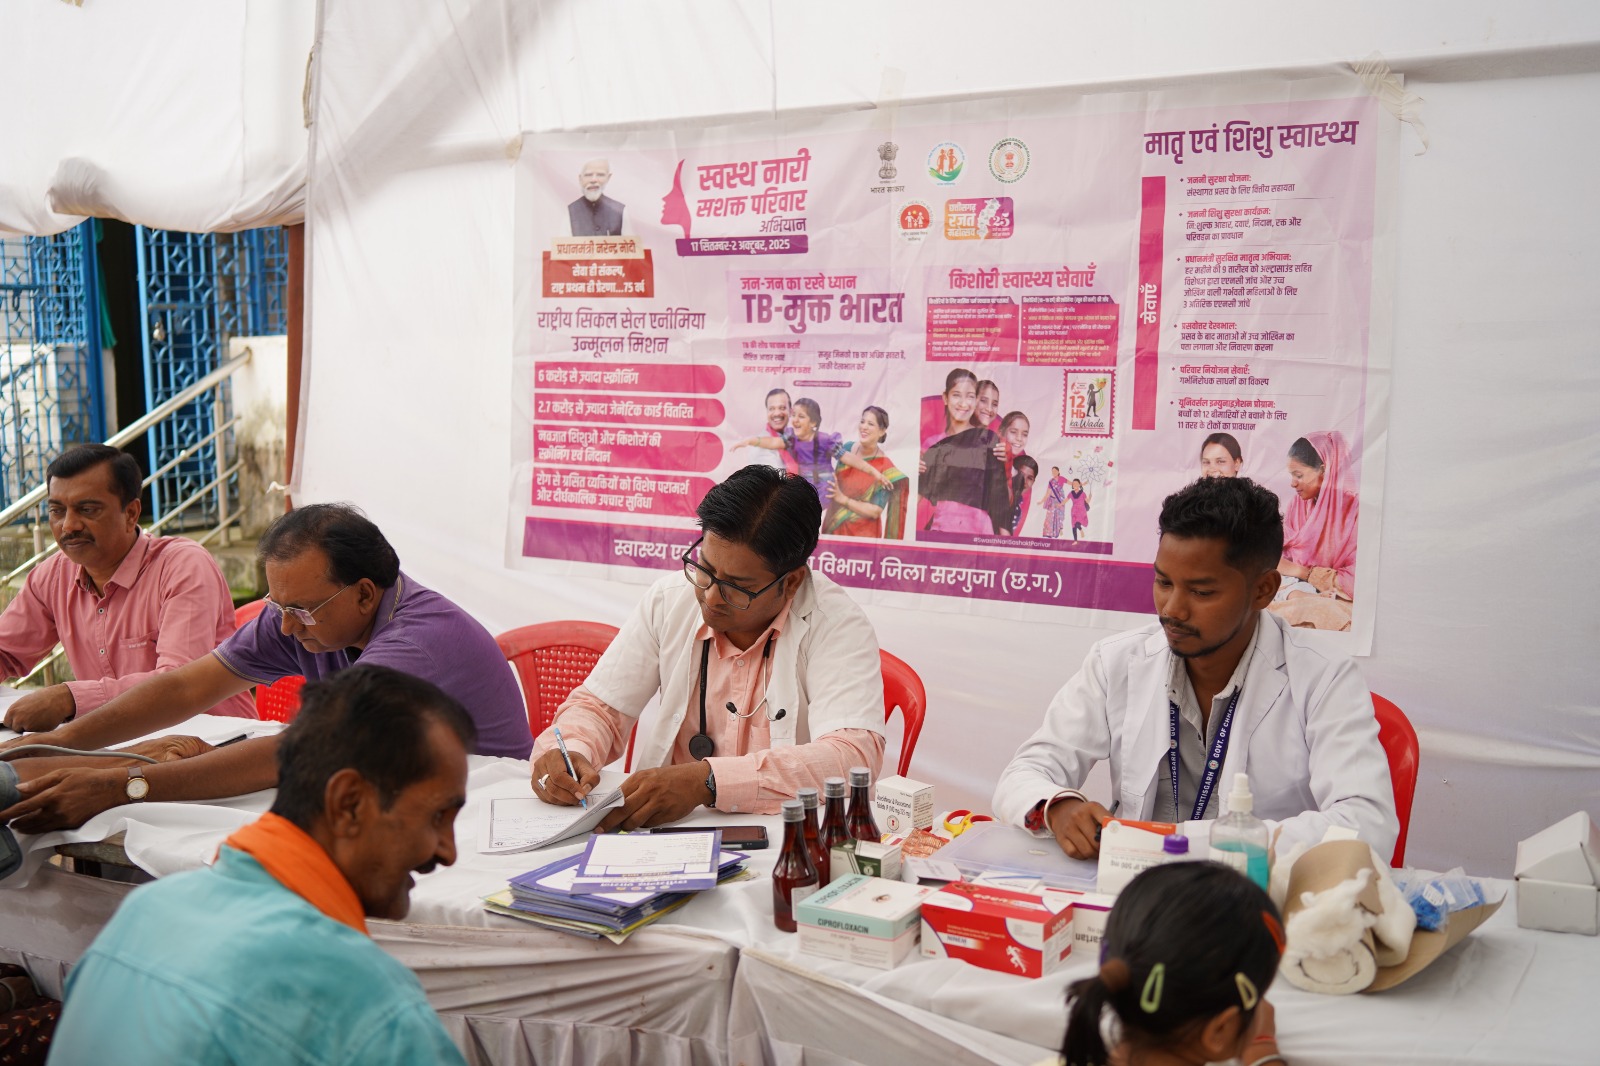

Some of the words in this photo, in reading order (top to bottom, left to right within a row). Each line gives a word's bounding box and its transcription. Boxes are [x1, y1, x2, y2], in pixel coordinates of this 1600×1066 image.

[1144, 132, 1185, 164] मातृ
[1189, 123, 1219, 152] एवं
[1223, 121, 1273, 159] शिशु
[1278, 121, 1359, 149] स्वास्थ्य
[698, 160, 757, 192] स्वस्थ
[761, 148, 812, 184] नारी
[1187, 174, 1207, 184] जननी
[1208, 175, 1227, 186] सुरक्षा
[696, 195, 748, 218] सशक्त
[751, 187, 807, 215] परिवार
[948, 214, 976, 228] रजत
[993, 213, 1010, 227] 25
[1188, 209, 1207, 218] जननी
[1208, 208, 1222, 219] शिशु
[1224, 209, 1242, 219] सुरक्षा
[1289, 217, 1301, 226] और
[760, 216, 807, 233] अभियान
[1186, 233, 1210, 241] परिवहन
[1221, 232, 1244, 240] प्रावधान
[691, 242, 698, 252] 17
[769, 239, 790, 250] 2025
[950, 268, 1000, 289] किशोरी
[1002, 271, 1053, 289] स्वास्थ्य
[1056, 262, 1096, 288] सेवाएँ
[1195, 265, 1211, 273] महीने
[1228, 264, 1249, 273] तारीख
[1251, 264, 1259, 273] को
[1295, 263, 1312, 272] सहित
[740, 277, 784, 291] जन-जन
[786, 277, 801, 290] का
[804, 273, 825, 290] रखे
[828, 275, 857, 289] ध्यान
[537, 307, 572, 331] राष्ट्रीय
[576, 308, 617, 329] सिकल
[620, 308, 645, 329] सेल
[650, 308, 707, 330] एनीमिया
[742, 294, 834, 334] TB-मुक्त
[840, 293, 905, 323] भारत
[1197, 331, 1203, 340] के
[1261, 331, 1284, 341] जोखिम
[572, 336, 625, 358] उन्मूलन
[628, 333, 669, 354] मिशन
[1215, 342, 1227, 351] और
[1229, 342, 1253, 351] निवारण
[538, 371, 544, 382] 6
[546, 367, 568, 384] करोड़
[570, 367, 577, 383] से
[1180, 365, 1201, 374] परिवार
[1203, 365, 1229, 374] नियोजन
[538, 401, 550, 413] 2.7
[553, 399, 574, 416] करोड़
[576, 400, 584, 414] से
[610, 401, 642, 416] जेनेटिक
[644, 402, 662, 417] कार्ड
[664, 403, 694, 419] वितरित
[1070, 396, 1085, 408] 12
[1071, 409, 1086, 419] Hb
[1241, 410, 1247, 419] से
[1248, 411, 1265, 420] बचाने
[1267, 411, 1272, 420] के
[1274, 411, 1287, 420] लिए
[1200, 421, 1205, 429] के
[1232, 423, 1256, 431] प्रावधान
[538, 430, 567, 443] नवजात
[600, 430, 615, 444] और
[649, 432, 662, 447] की
[537, 472, 551, 486] रोग
[553, 472, 561, 486] से
[563, 474, 586, 488] ग्रसित
[620, 477, 631, 491] को
[633, 479, 656, 493] विशेष
[658, 480, 690, 495] परामर्श
[614, 539, 668, 559] स्वास्थ्य
[819, 552, 876, 581] विभाग,
[881, 556, 927, 583] जिला
[931, 565, 996, 593] सरगुजा
[1002, 568, 1062, 597] (छ.ग.)
[1194, 771, 1215, 820] CHHATTISGARH
[1213, 736, 1224, 758] GOVT.
[1220, 728, 1227, 738] OF
[817, 918, 869, 934] CIPROFLOXACIN
[1075, 932, 1105, 944] artan
